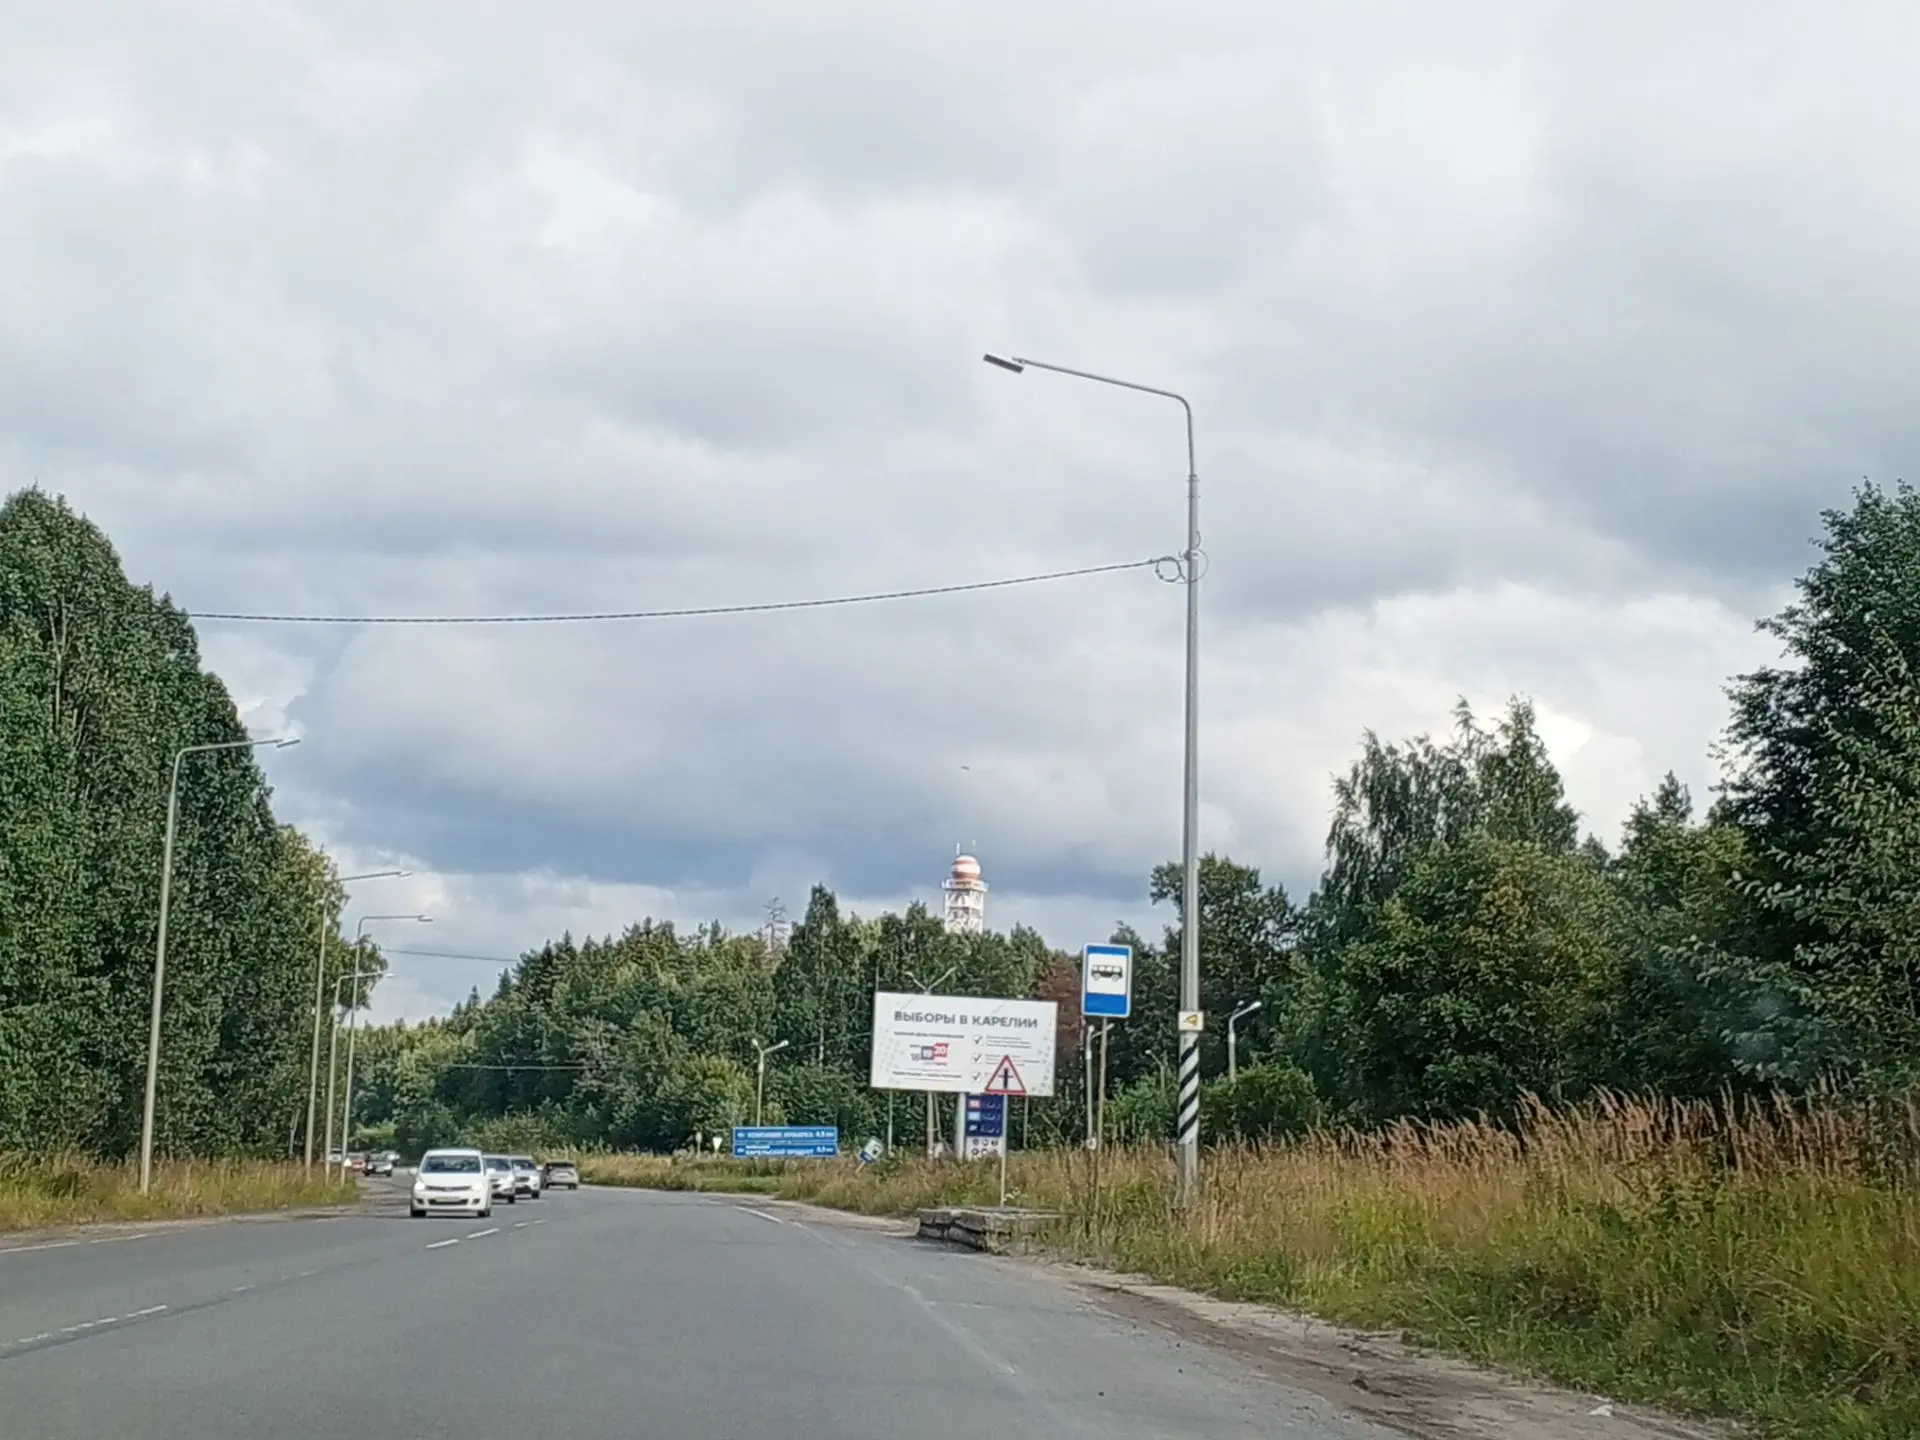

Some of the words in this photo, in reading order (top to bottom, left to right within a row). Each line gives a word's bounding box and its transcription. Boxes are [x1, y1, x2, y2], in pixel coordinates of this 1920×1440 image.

[894, 1011, 956, 1024] ВЫБОРЫ
[959, 1014, 968, 1025] В
[972, 1015, 1038, 1028] КАРЕЛИИ
